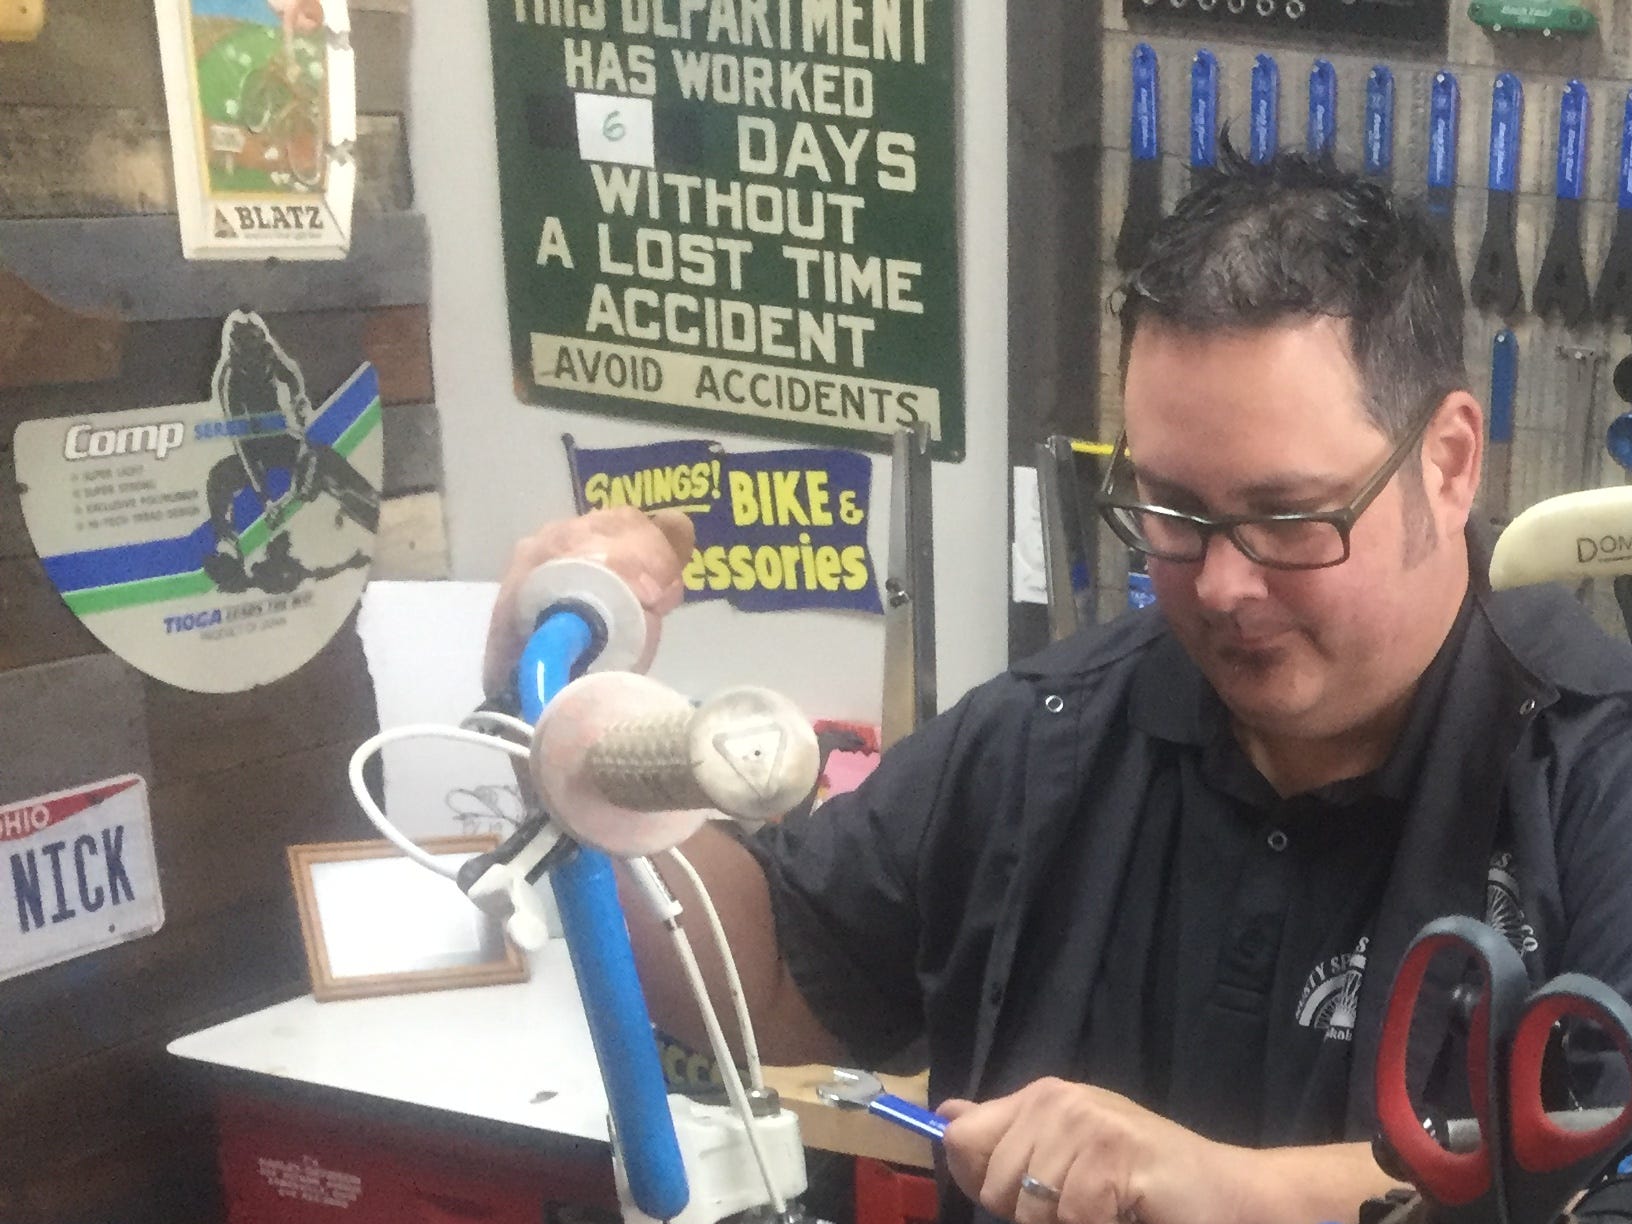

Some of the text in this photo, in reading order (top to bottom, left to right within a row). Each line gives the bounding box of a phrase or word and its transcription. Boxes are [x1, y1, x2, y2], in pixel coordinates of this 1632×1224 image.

[564, 38, 873, 119] HAS WORKED
[602, 110, 626, 142] 6
[737, 115, 916, 193] DAYS
[234, 206, 323, 229] BLATZ
[590, 164, 865, 244] WITHOUT
[536, 217, 924, 314] A LOST TIME
[585, 283, 875, 368] ACCIDENT
[553, 346, 919, 426] AVOID ACCIDENTS
[64, 421, 185, 461] Comp
[585, 460, 864, 527] SAVINGS! BIKE &
[681, 532, 868, 591] essories
[0, 804, 50, 837] HIO
[10, 825, 136, 934] NICK
